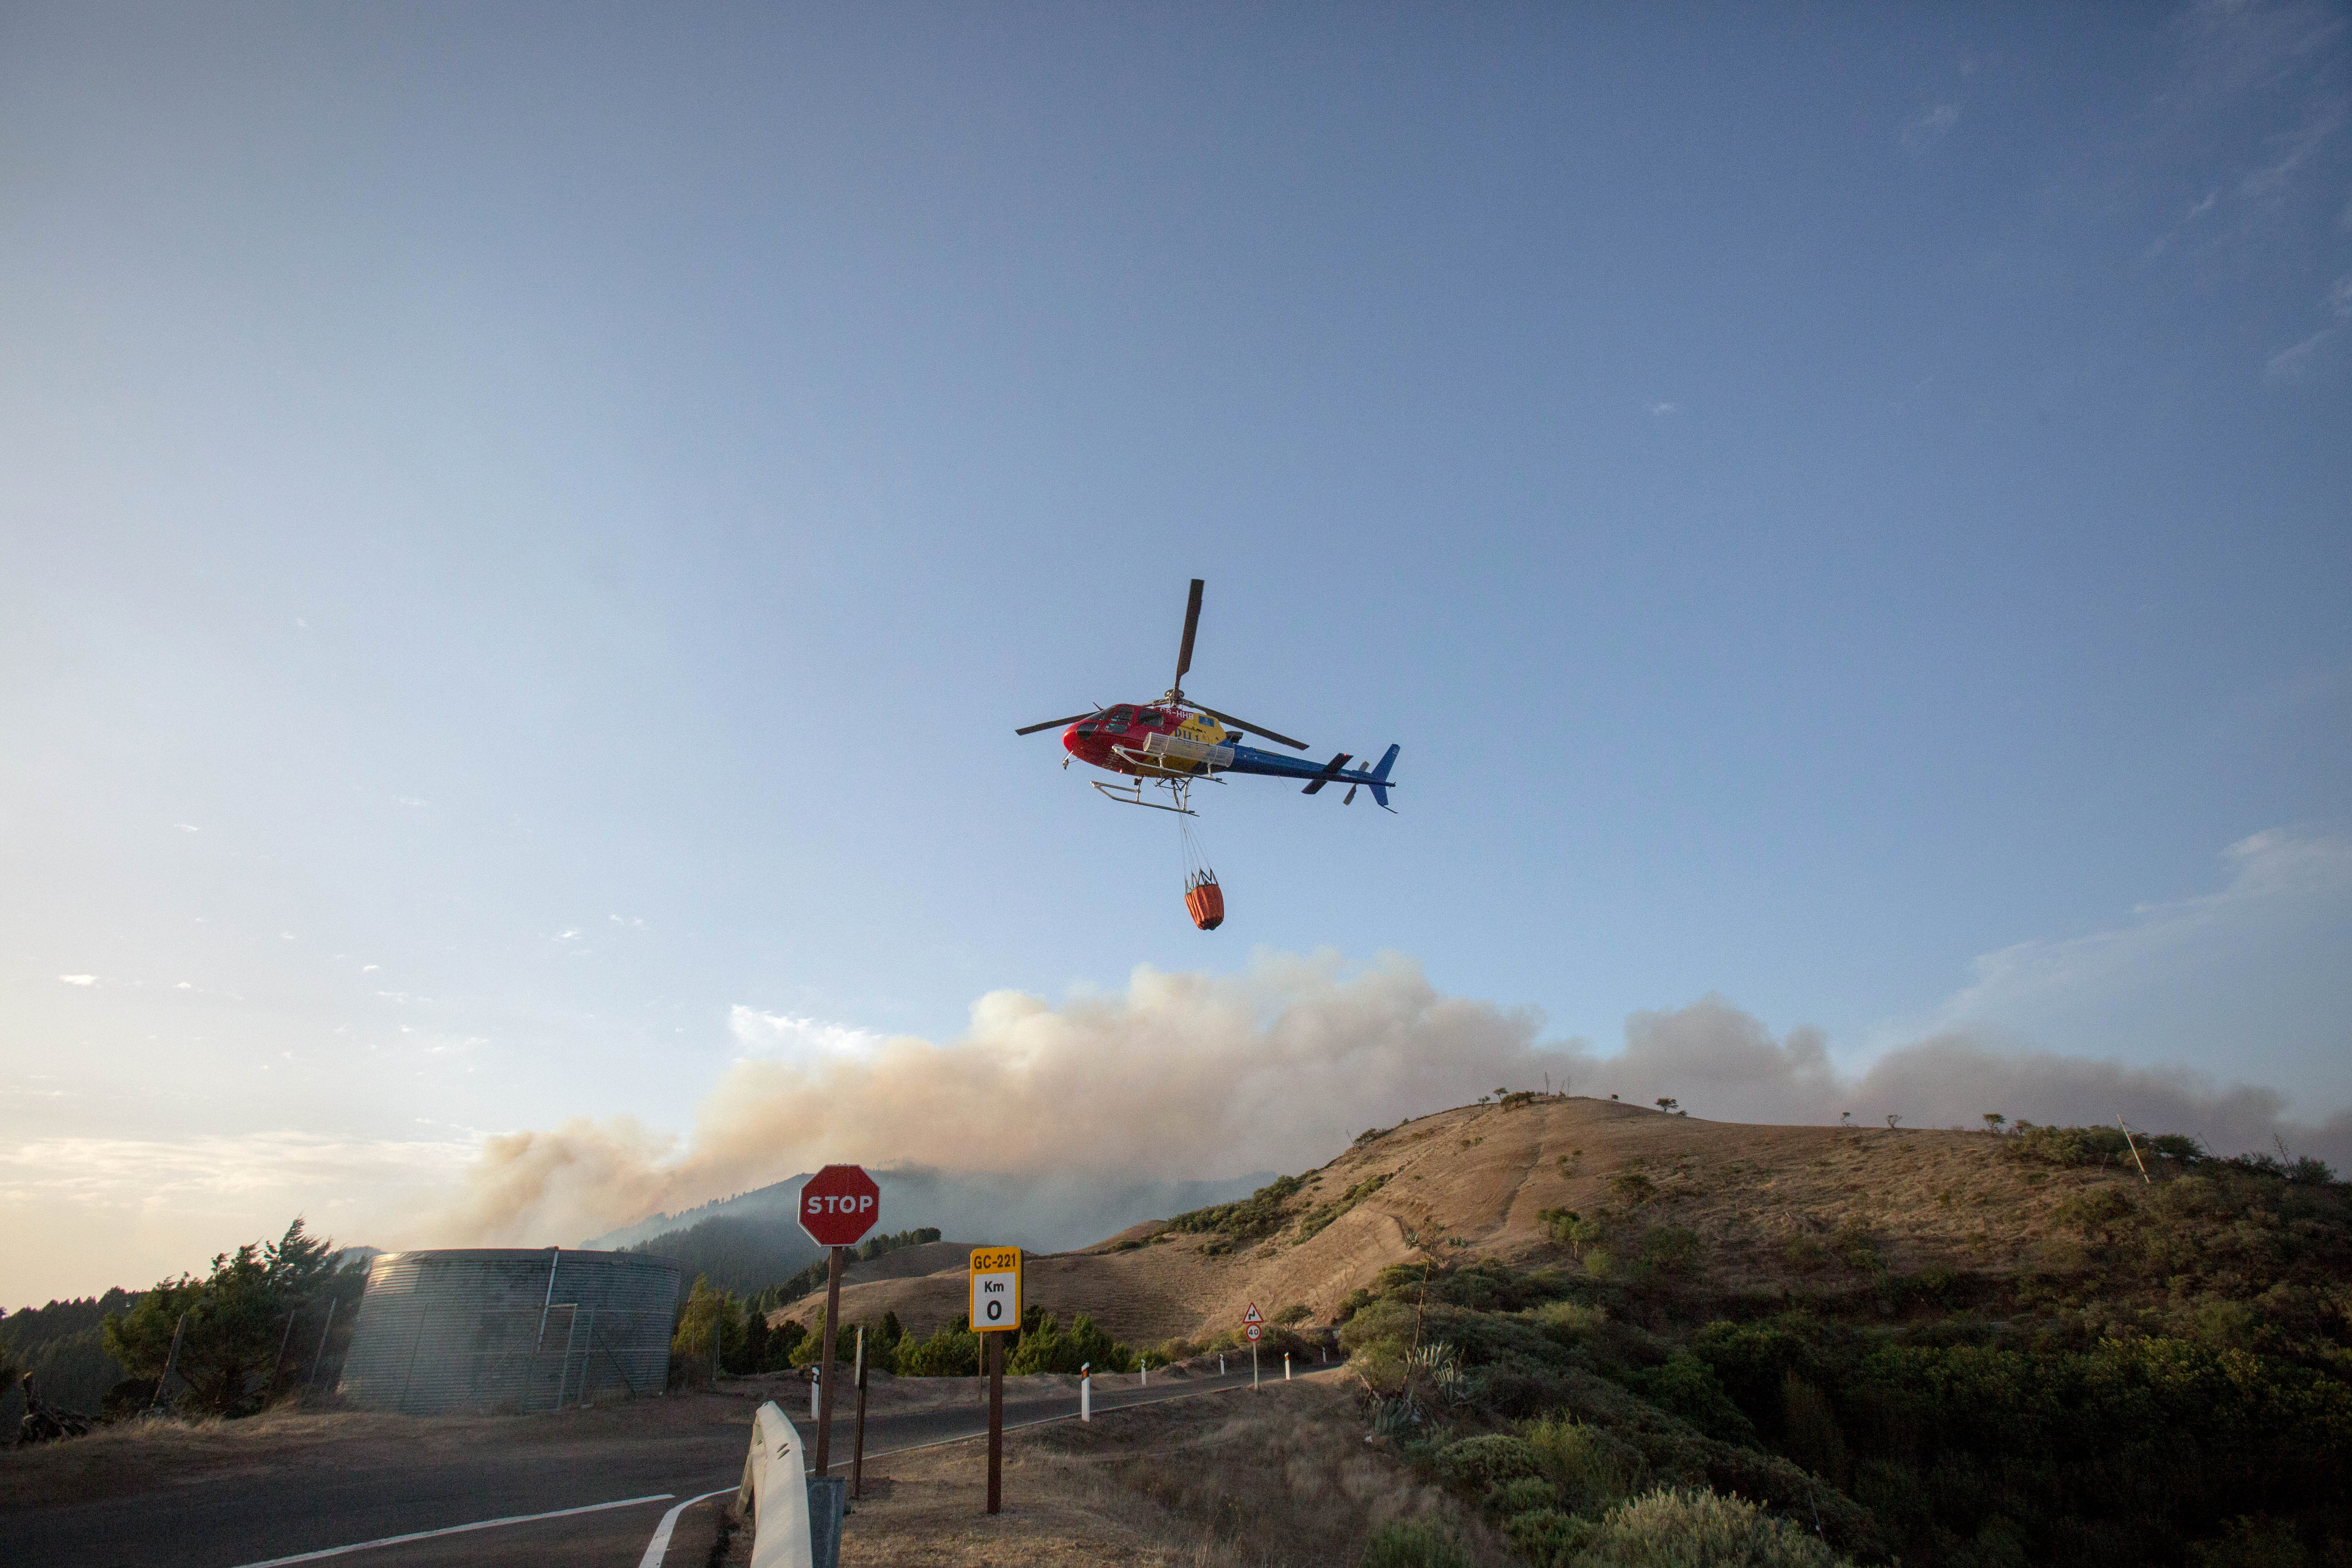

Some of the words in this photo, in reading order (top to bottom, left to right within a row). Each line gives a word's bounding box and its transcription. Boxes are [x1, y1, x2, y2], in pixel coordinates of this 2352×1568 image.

[807, 1196, 873, 1214] STOP
[974, 1253, 1016, 1270] GC-221
[984, 1281, 1004, 1292] Km
[987, 1300, 1002, 1320] 0
